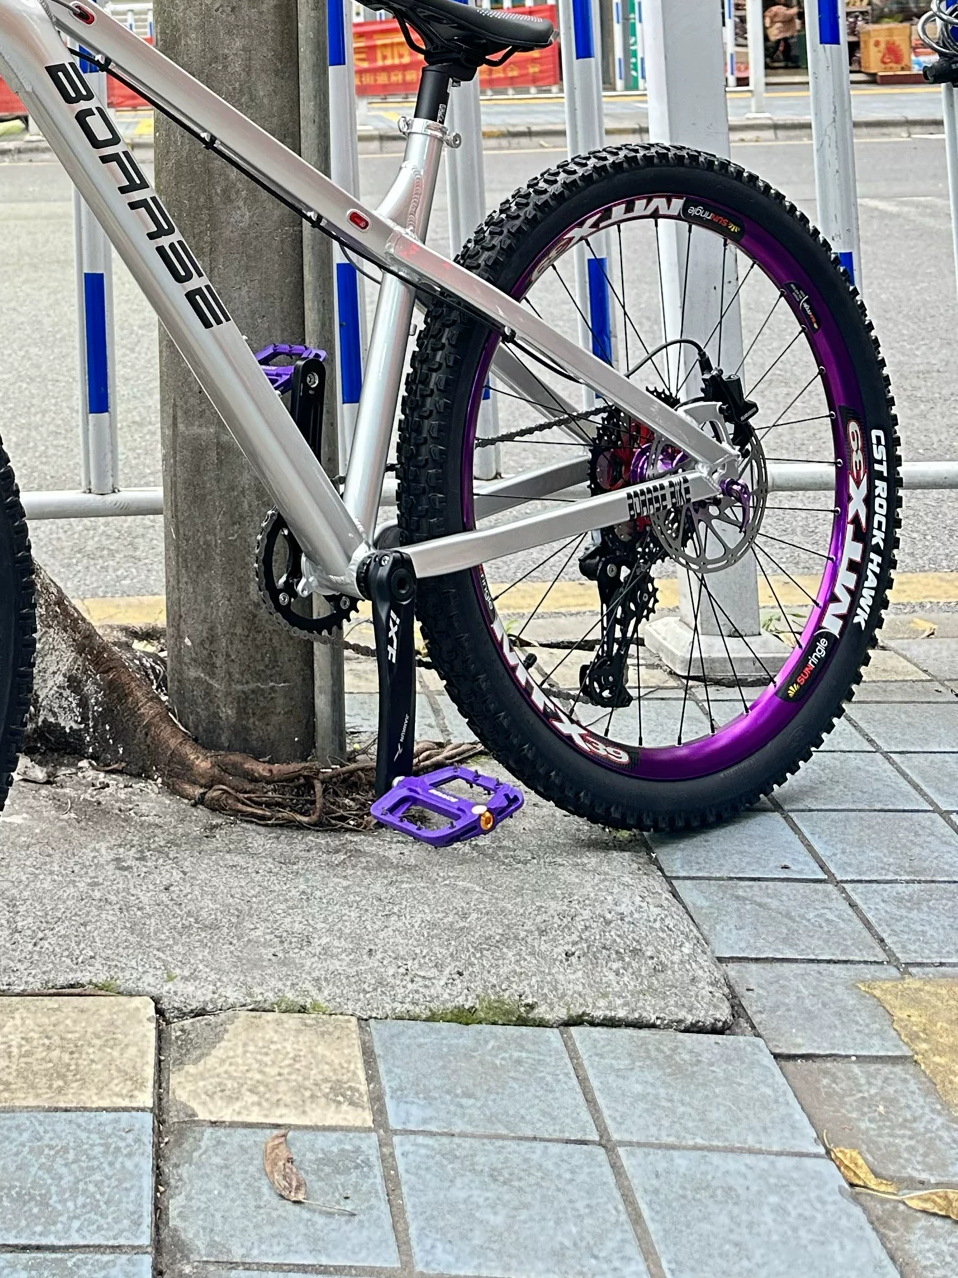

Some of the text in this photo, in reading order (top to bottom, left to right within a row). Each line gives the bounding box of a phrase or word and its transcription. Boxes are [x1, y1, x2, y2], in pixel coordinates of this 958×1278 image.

[44, 61, 232, 330] BOARSE
[853, 428, 888, 631] CST ROCK HAWK
